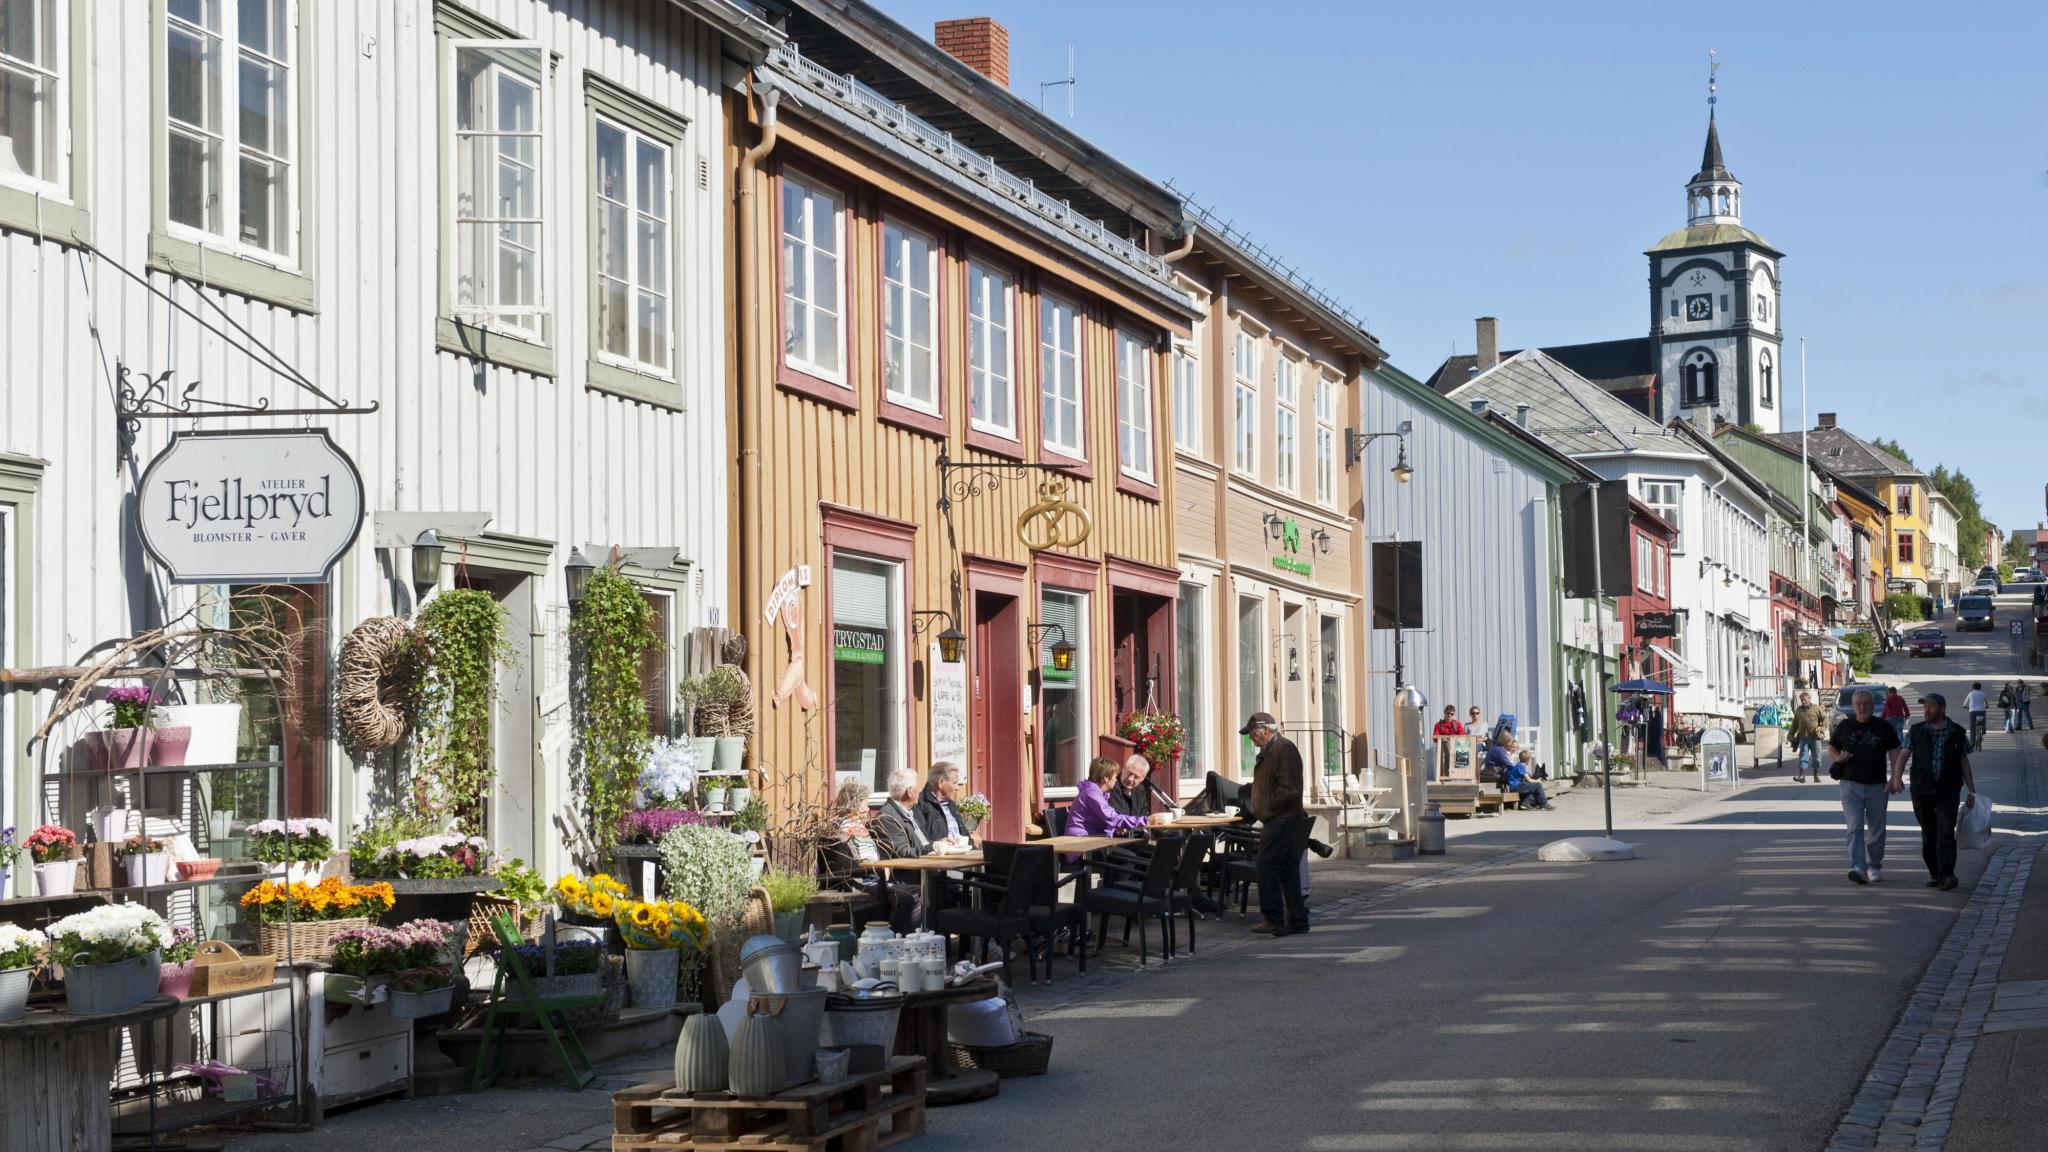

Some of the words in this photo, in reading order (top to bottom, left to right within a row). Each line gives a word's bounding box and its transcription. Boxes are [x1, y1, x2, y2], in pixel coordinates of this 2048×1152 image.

[259, 479, 306, 489] ATELIER
[164, 474, 333, 529] Fjellpryd
[193, 532, 252, 543] BLOMSTER
[270, 531, 306, 542] GAVER
[833, 629, 885, 652] TRYGSTAD
